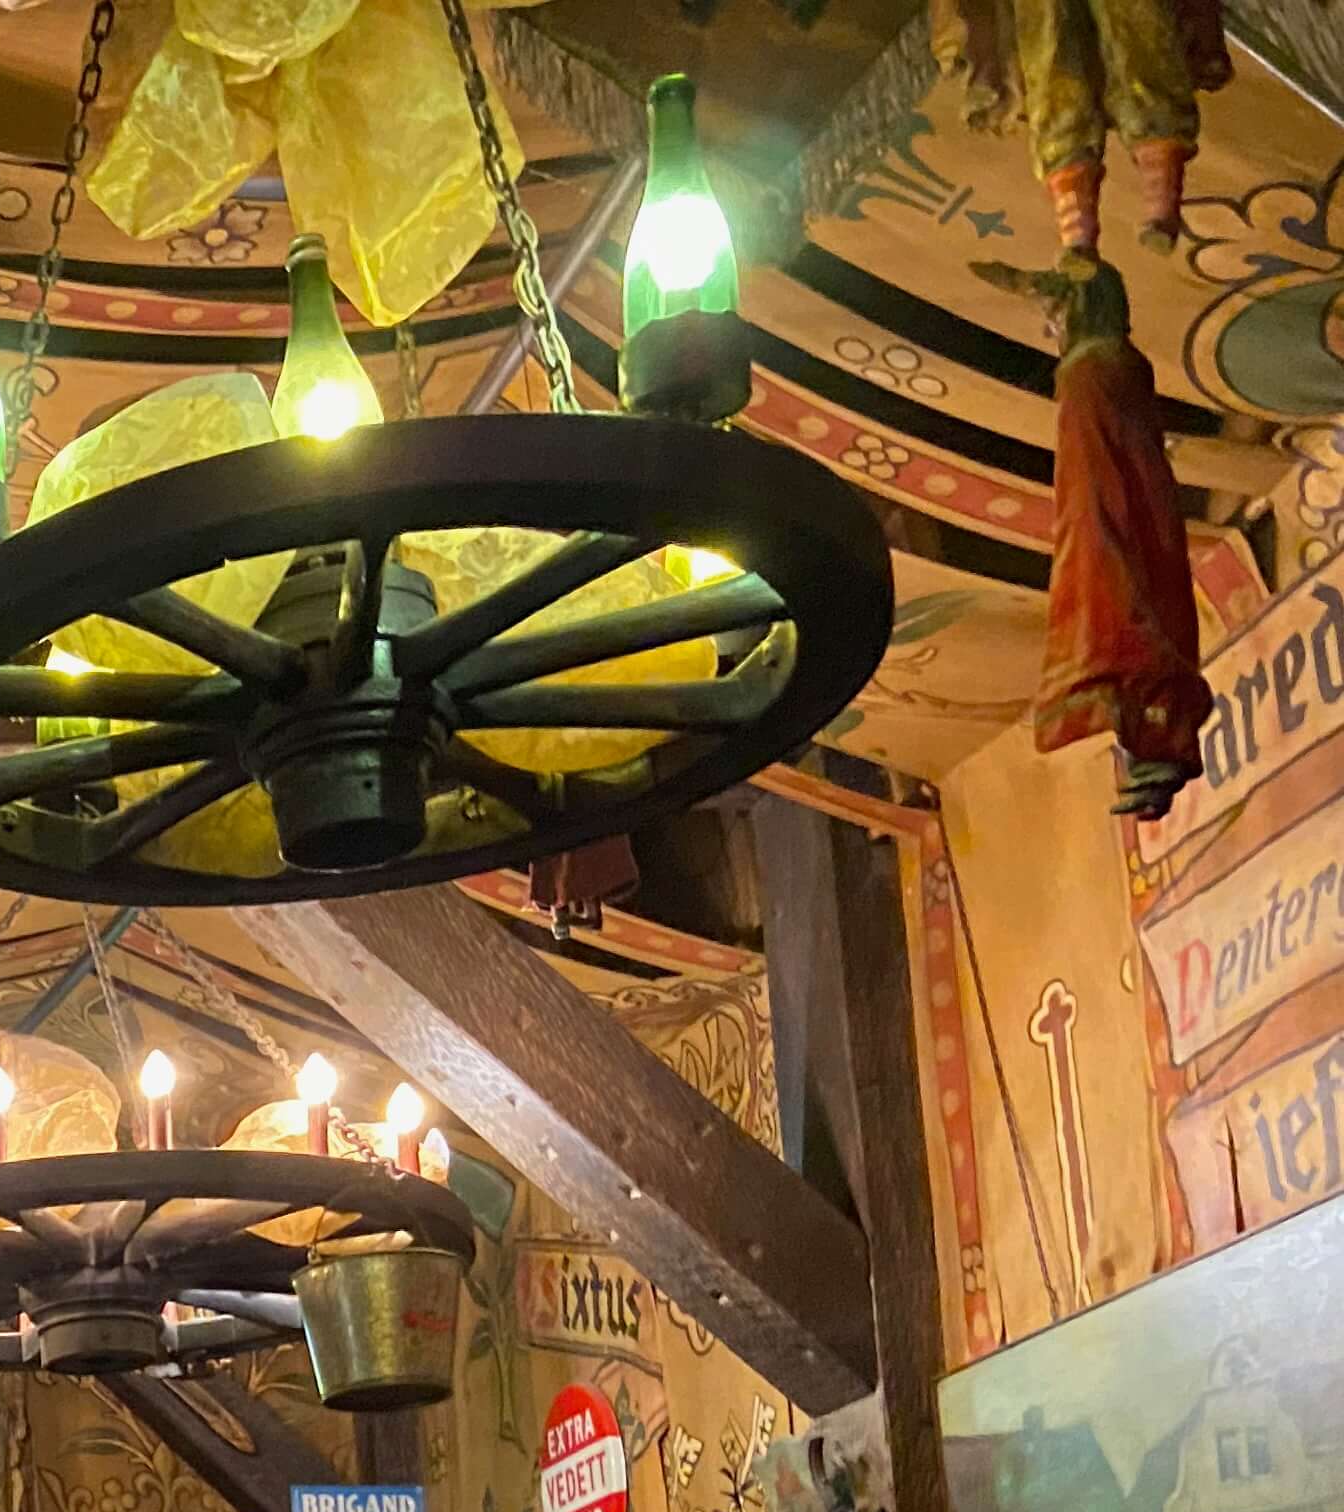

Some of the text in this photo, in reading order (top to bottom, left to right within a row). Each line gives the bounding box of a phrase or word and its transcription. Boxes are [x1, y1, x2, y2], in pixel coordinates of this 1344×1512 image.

[1204, 581, 1344, 790] ared
[1174, 860, 1344, 1038] Denter
[517, 1254, 642, 1342] Sixtus
[546, 1407, 596, 1459] EXTRA
[545, 1449, 608, 1511] VEDETT
